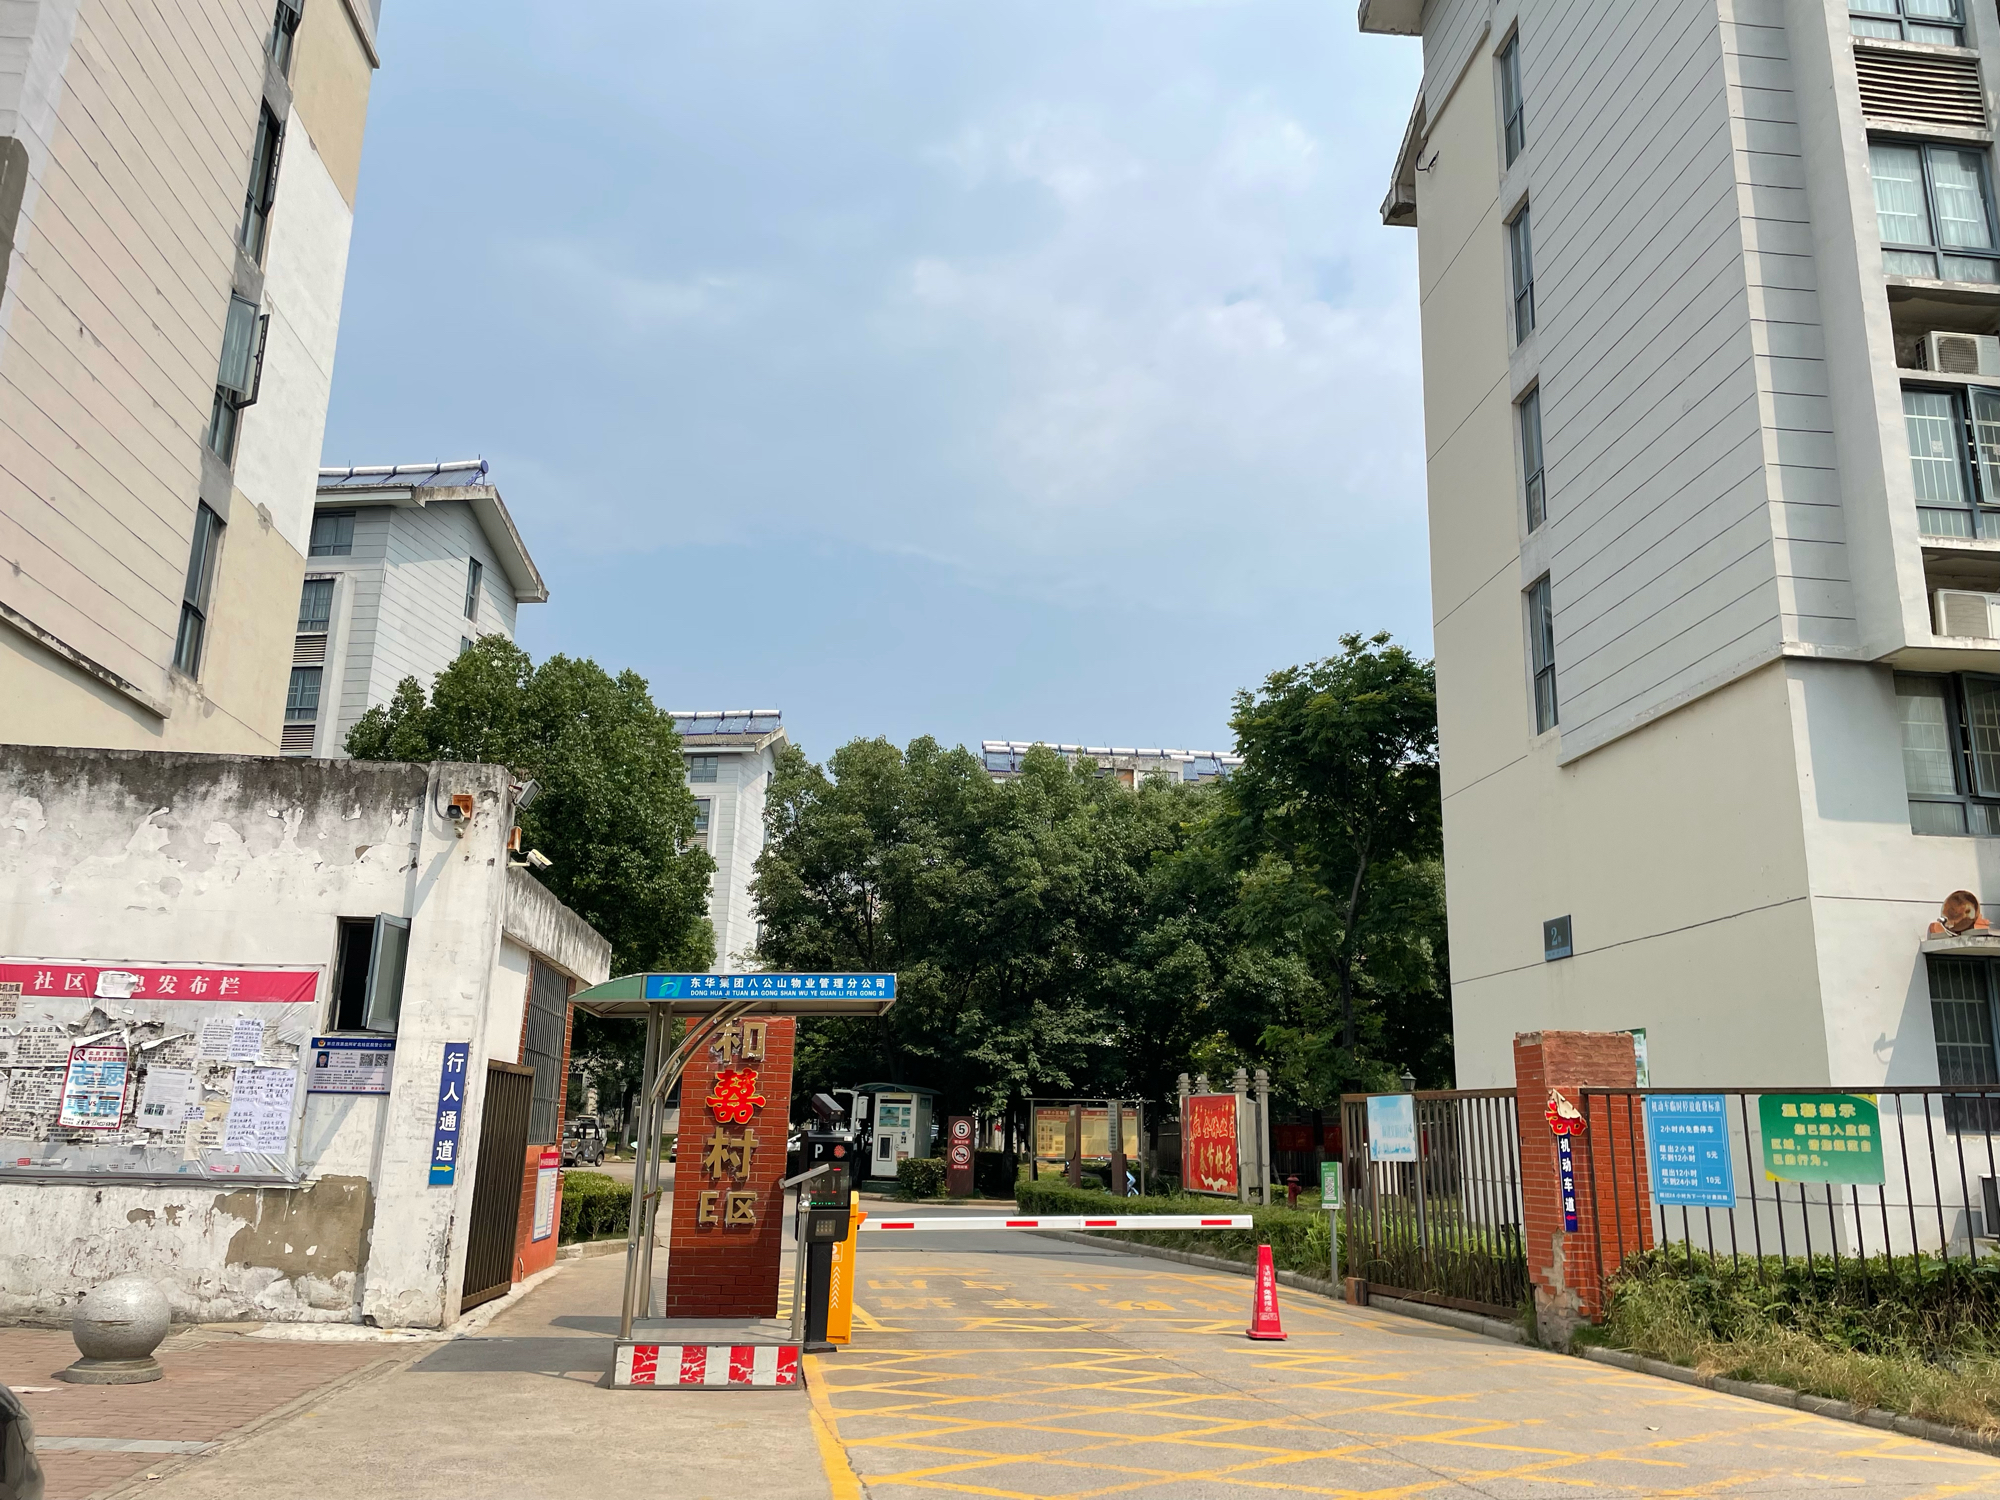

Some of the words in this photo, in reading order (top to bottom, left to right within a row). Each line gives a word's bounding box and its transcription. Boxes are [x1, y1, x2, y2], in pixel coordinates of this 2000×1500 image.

[34, 971, 241, 995] 社区息发布栏
[690, 977, 886, 989] 东华集团八公山物业管理分公司
[435, 1051, 465, 1161] 行人通道
[1781, 1103, 1857, 1118] 温馨提示
[958, 1124, 966, 1135] 5
[1660, 1124, 1714, 1135] 2小时内免费停车
[1794, 1123, 1871, 1137] 您已进入监控
[814, 1143, 824, 1159] P
[1659, 1144, 1695, 1154] 超出2小时
[1706, 1149, 1719, 1160] 5元
[1660, 1154, 1696, 1164] 不到12小时
[1560, 1137, 1576, 1212] 机动车道
[1661, 1168, 1698, 1178] 超出12小时
[1662, 1177, 1698, 1187] 不到24小时
[1705, 1175, 1722, 1185] 10元
